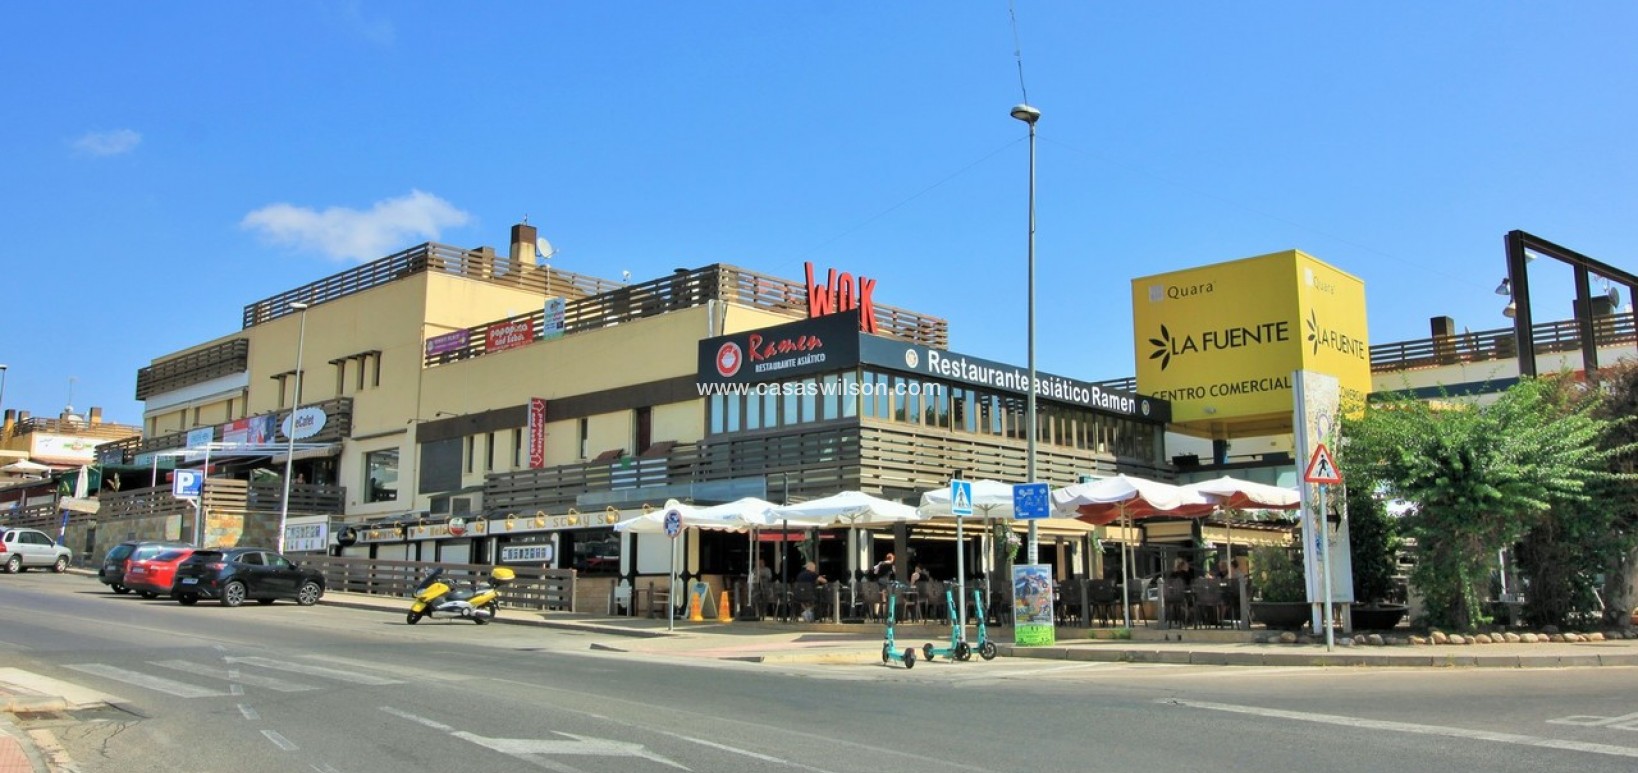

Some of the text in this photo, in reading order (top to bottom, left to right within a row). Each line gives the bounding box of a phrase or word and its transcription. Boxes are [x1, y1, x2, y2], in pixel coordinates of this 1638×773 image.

[804, 261, 877, 335] WOK
[1167, 282, 1214, 299] Quara
[748, 333, 823, 362] Ramen
[1171, 321, 1290, 355] LA FUENTE
[1317, 325, 1365, 360] LA FUENTE
[755, 353, 826, 373] RESTAURANTE ASIÁTICO
[928, 350, 1136, 414] Restaurante asiático Ramen
[1209, 376, 1292, 397] COMERCIAL
[177, 472, 195, 494] P
